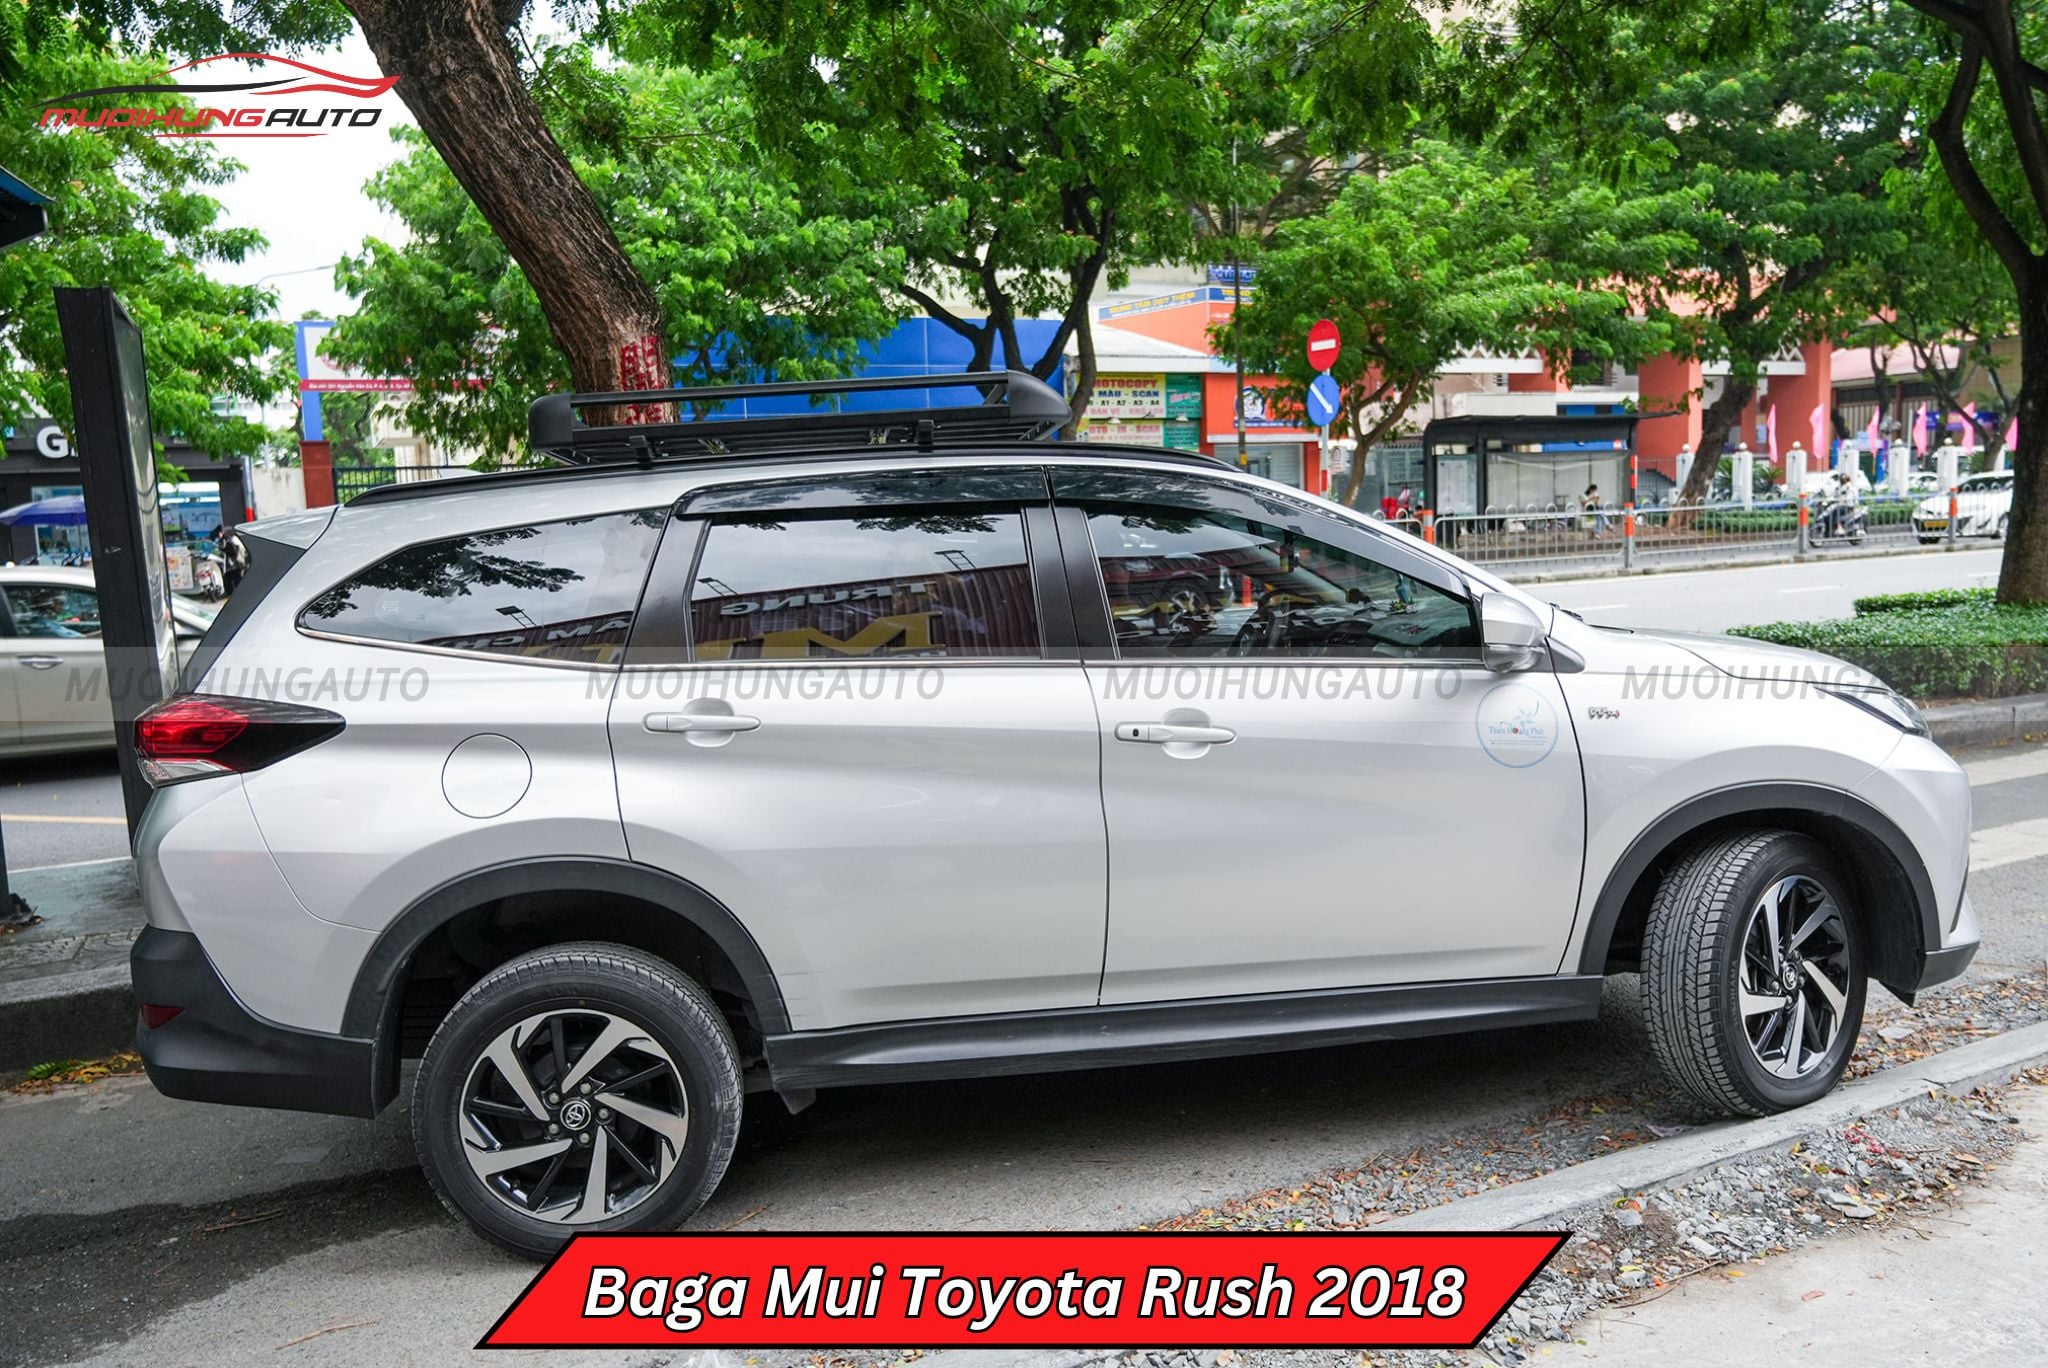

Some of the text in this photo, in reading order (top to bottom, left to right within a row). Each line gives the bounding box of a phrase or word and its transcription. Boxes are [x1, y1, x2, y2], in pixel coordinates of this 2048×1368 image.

[1092, 379, 1159, 389] HOTOCOPY
[1131, 390, 1160, 398] SCAN
[1088, 424, 1108, 433] OTO
